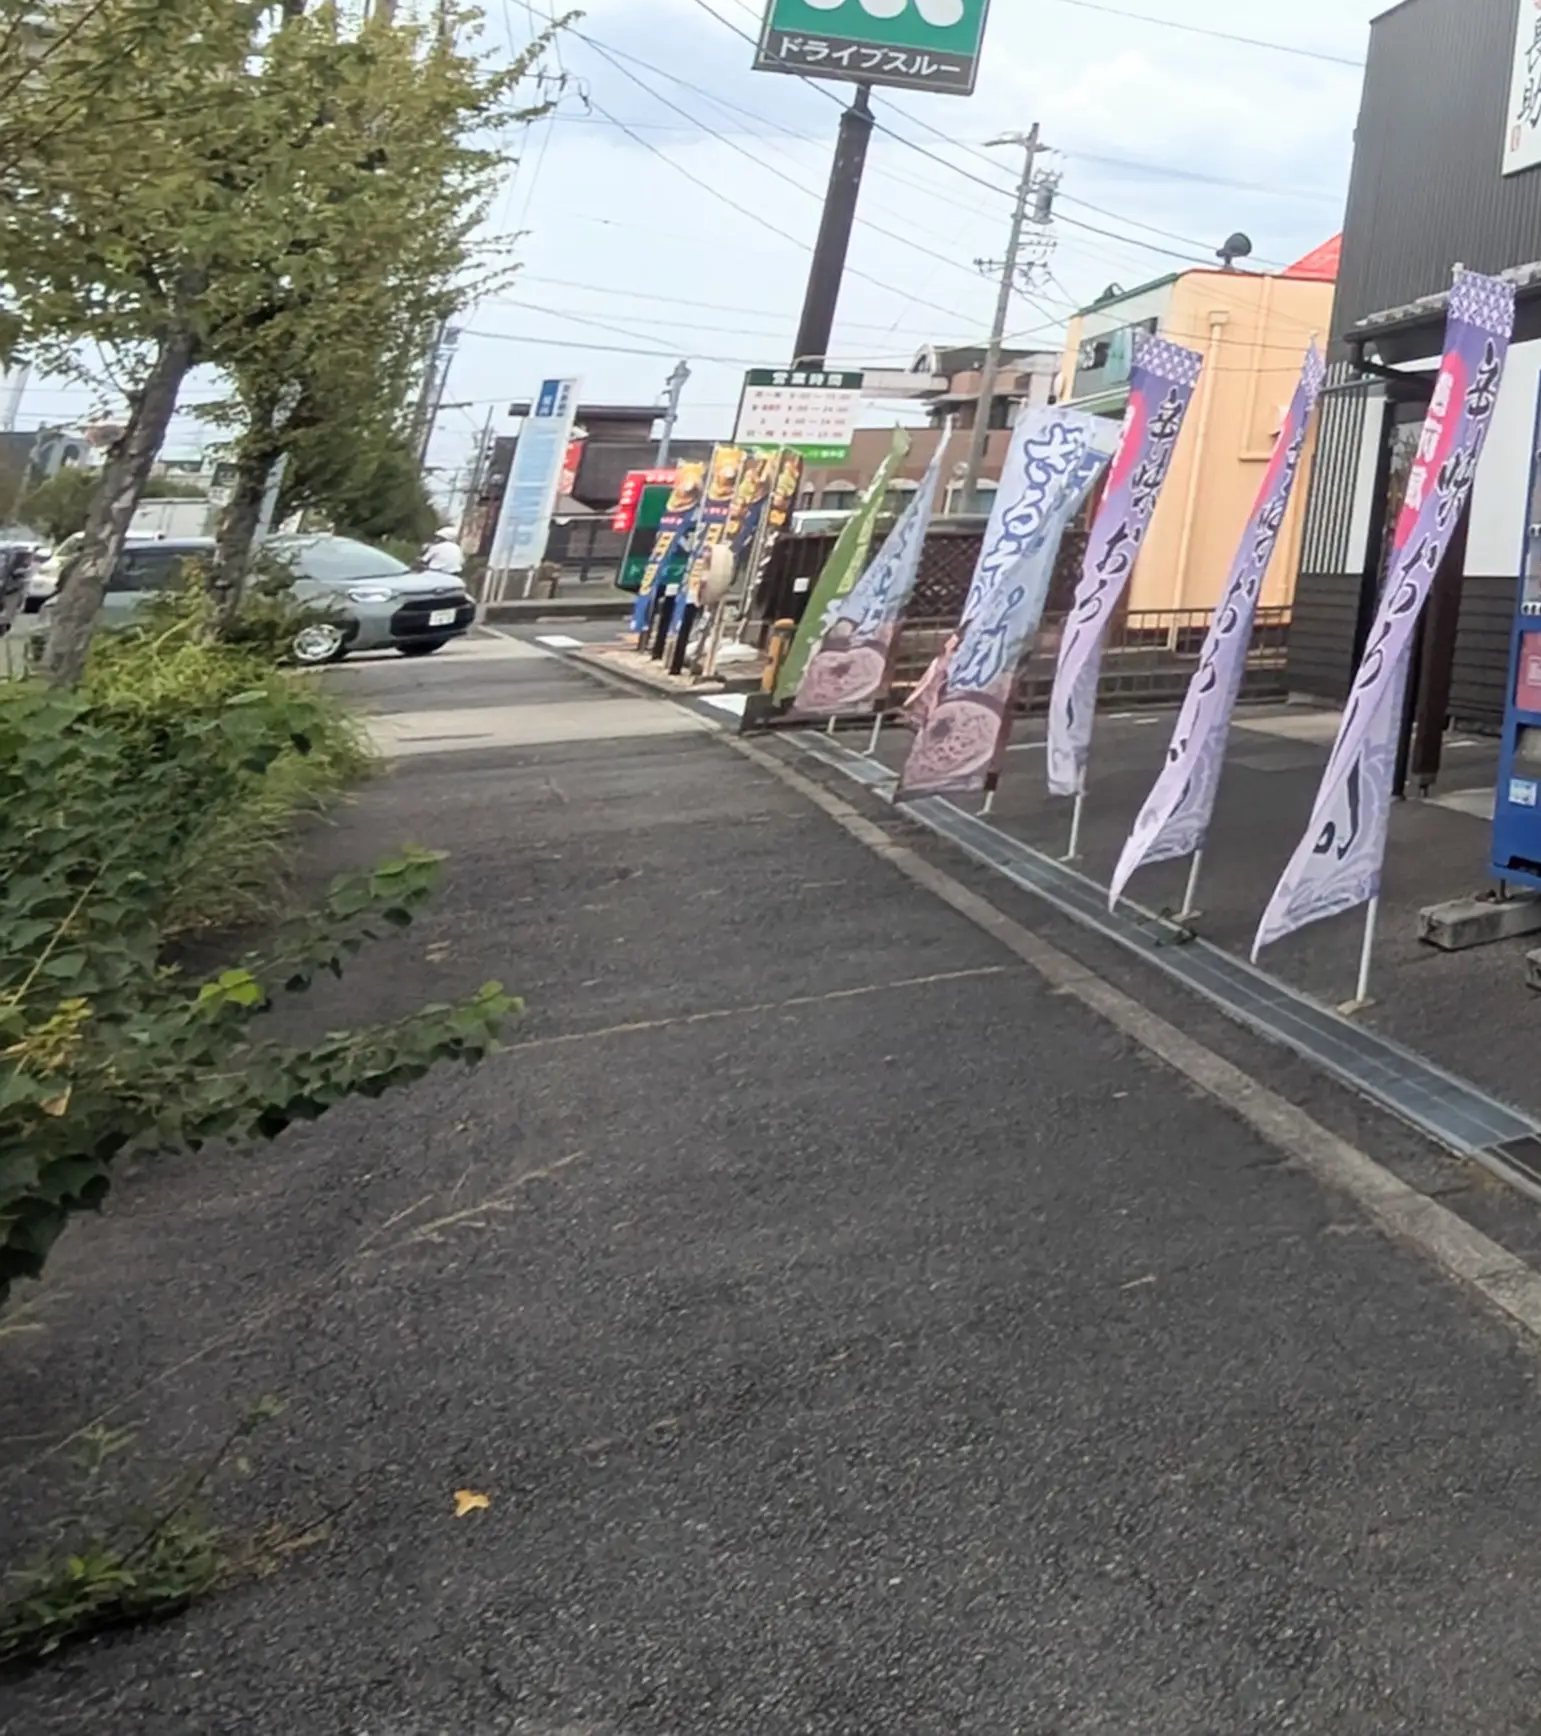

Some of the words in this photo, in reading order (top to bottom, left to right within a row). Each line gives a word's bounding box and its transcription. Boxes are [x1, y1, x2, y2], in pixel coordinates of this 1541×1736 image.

[778, 36, 962, 77] ドライブスルー
